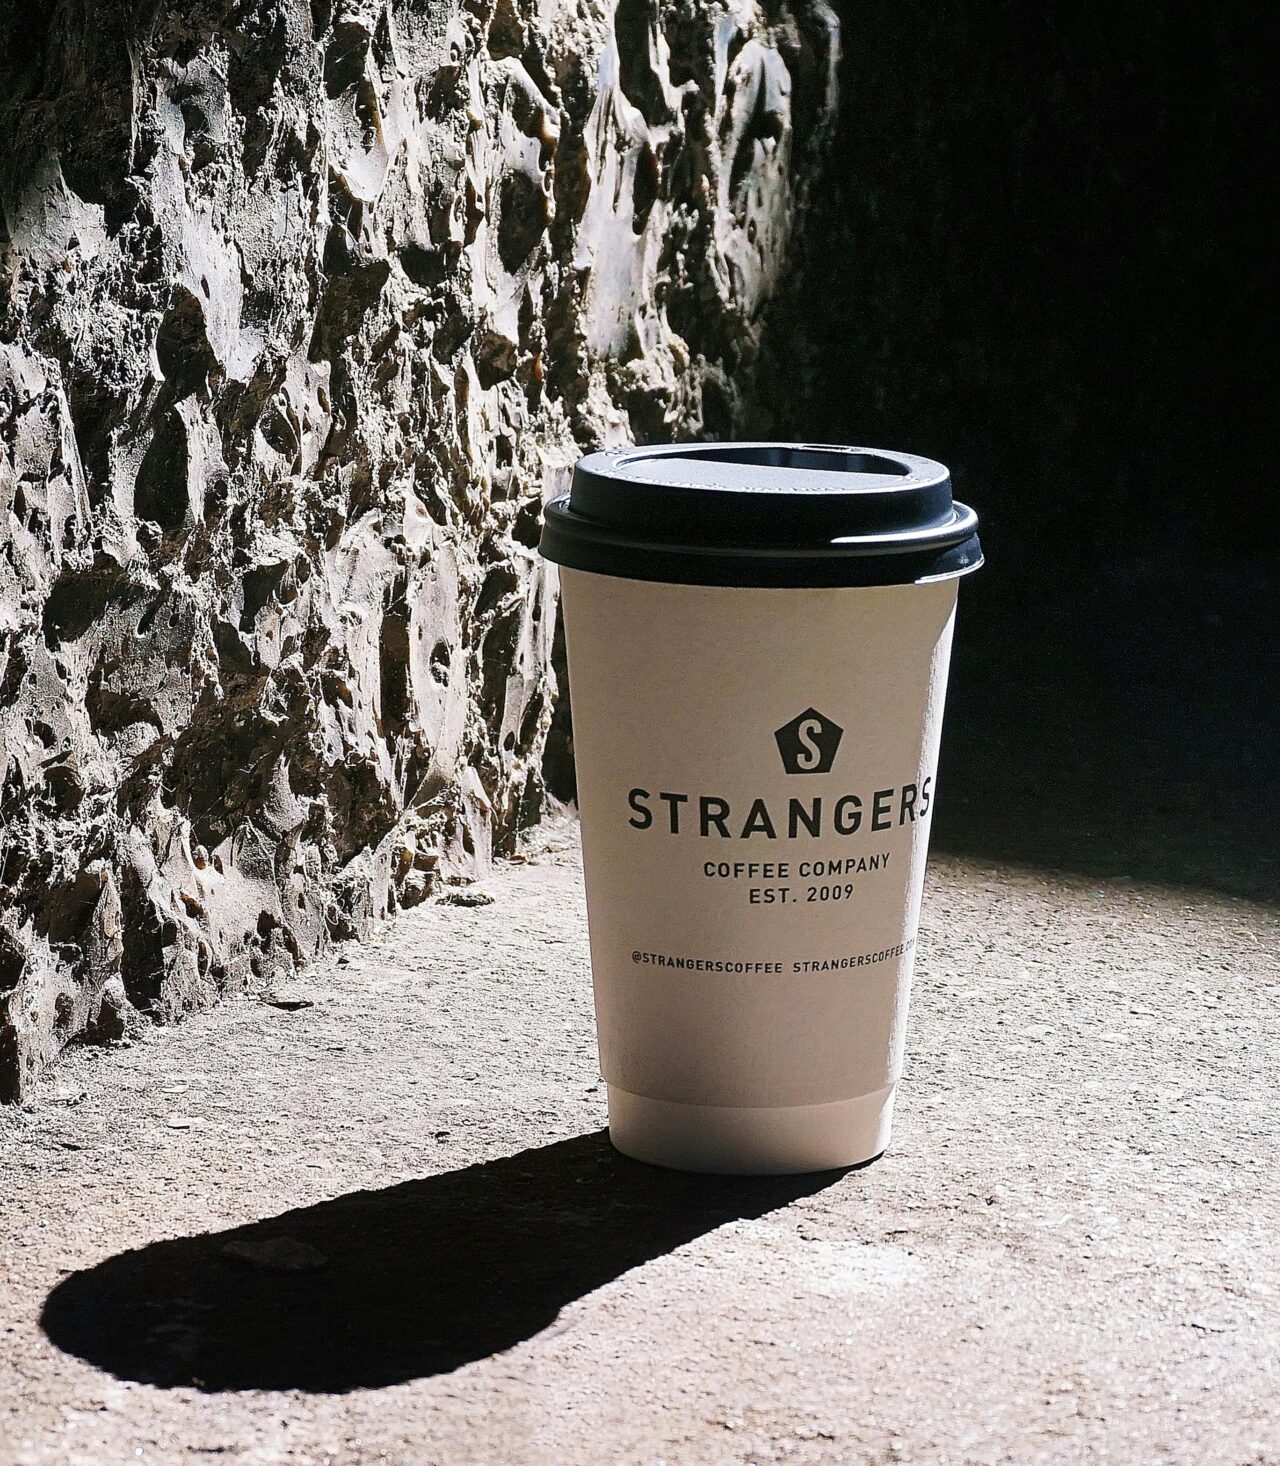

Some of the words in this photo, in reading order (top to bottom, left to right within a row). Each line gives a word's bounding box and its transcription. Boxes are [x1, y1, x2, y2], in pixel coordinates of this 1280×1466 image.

[796, 718, 823, 770] S
[628, 776, 932, 839] STRANGERS
[703, 861, 790, 879] COFFEE
[798, 852, 891, 877] COMPANY
[749, 888, 798, 904] EST.
[807, 884, 854, 902] 2009
[631, 950, 784, 974] @STRANGERSCOFFEE
